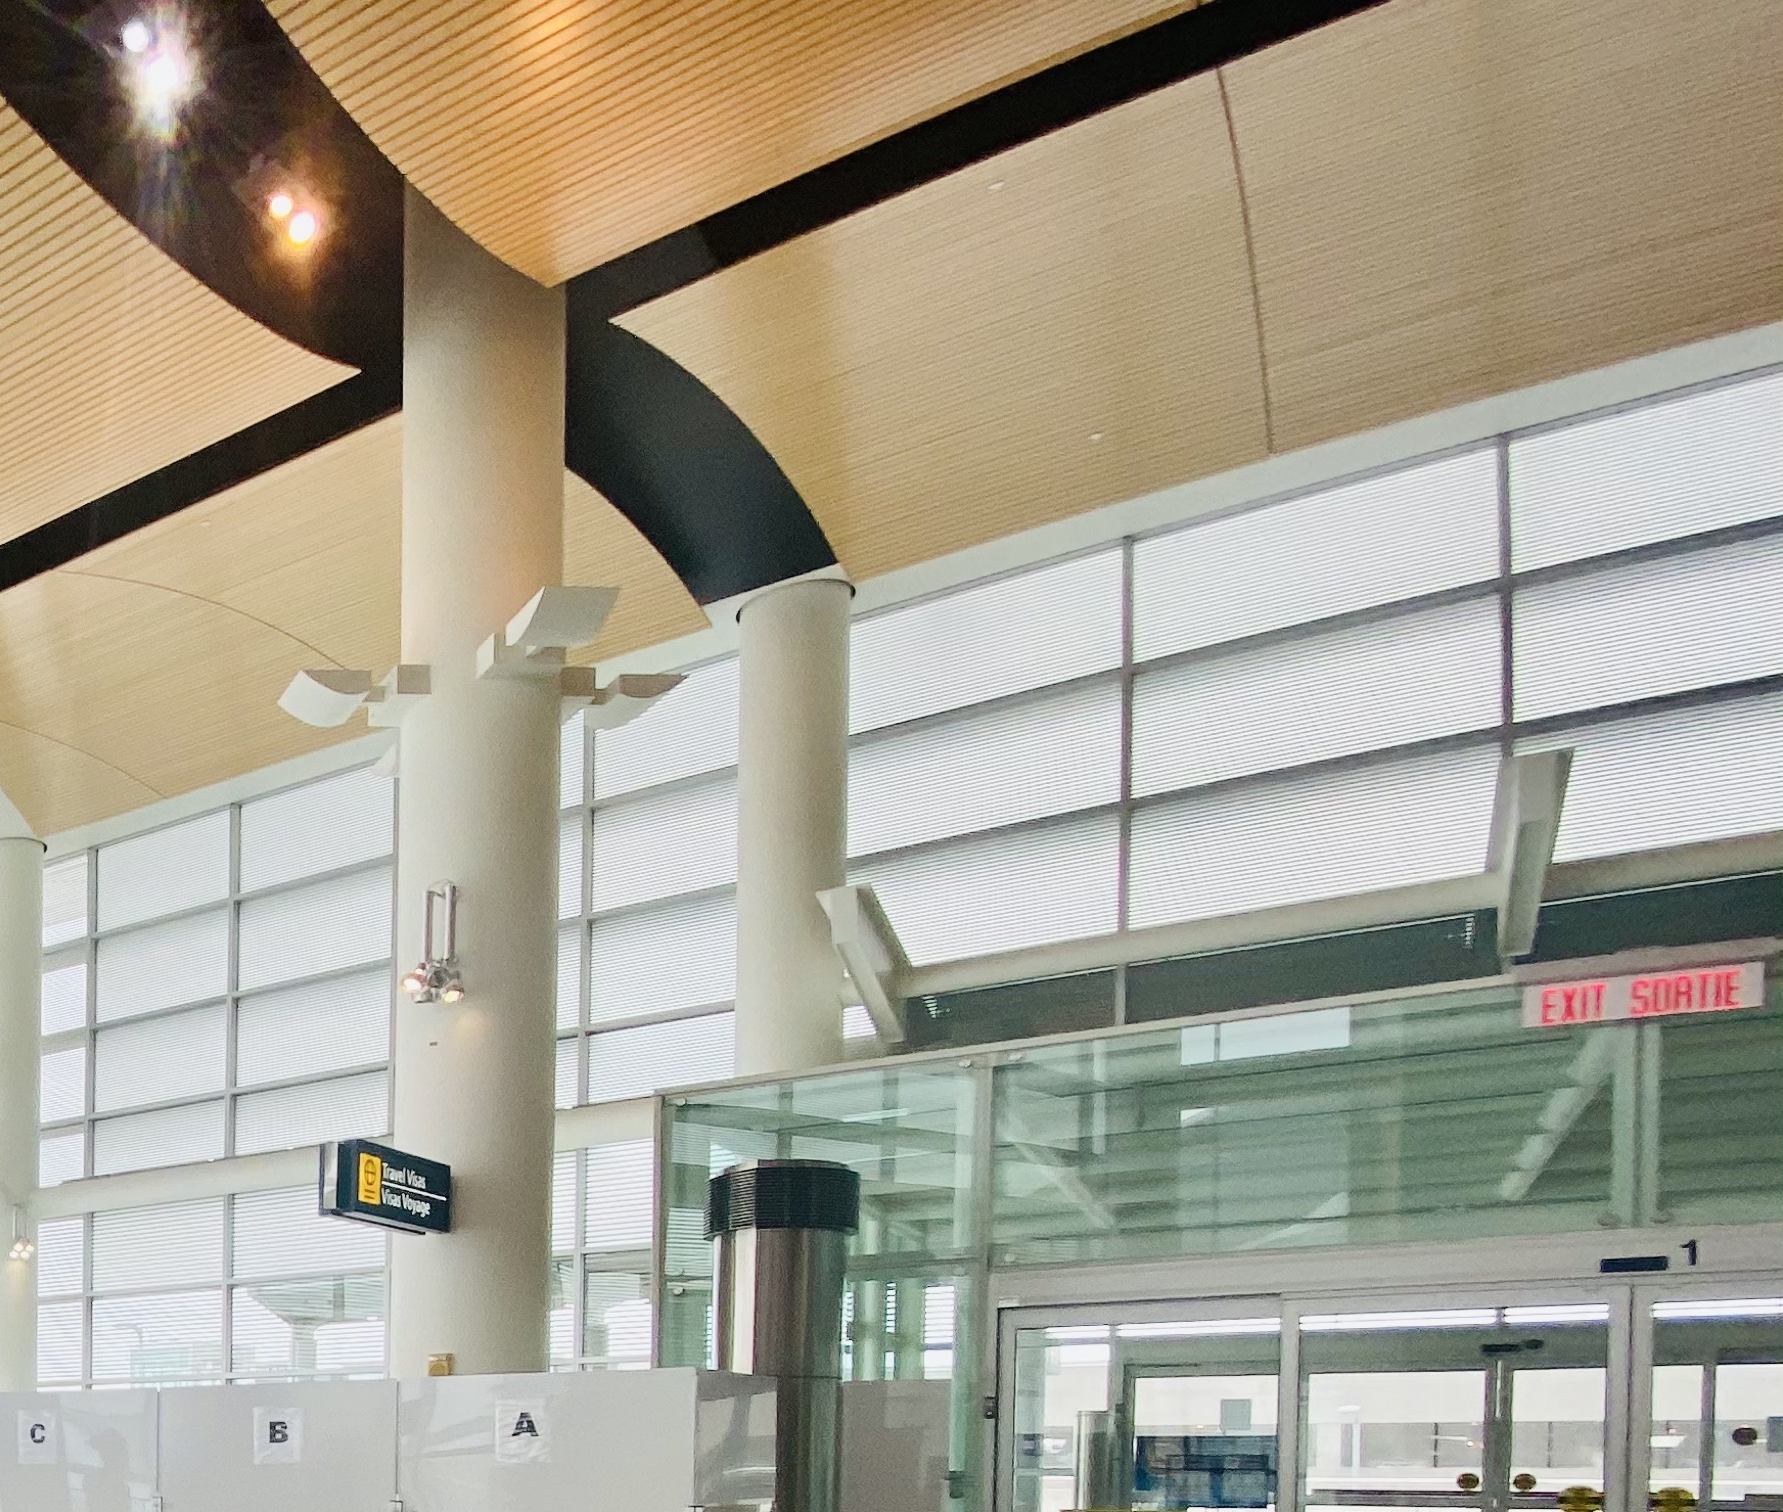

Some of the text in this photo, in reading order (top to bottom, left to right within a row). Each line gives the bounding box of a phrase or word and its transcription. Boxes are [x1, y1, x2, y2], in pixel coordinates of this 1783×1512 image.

[1541, 967, 1741, 1025] EXIT SORTIE
[382, 1162, 406, 1184] Travel
[401, 1192, 431, 1218] Voyage
[1680, 1239, 1699, 1266] 1
[29, 1423, 47, 1444] C
[268, 1421, 289, 1443] B
[511, 1411, 539, 1437] A
